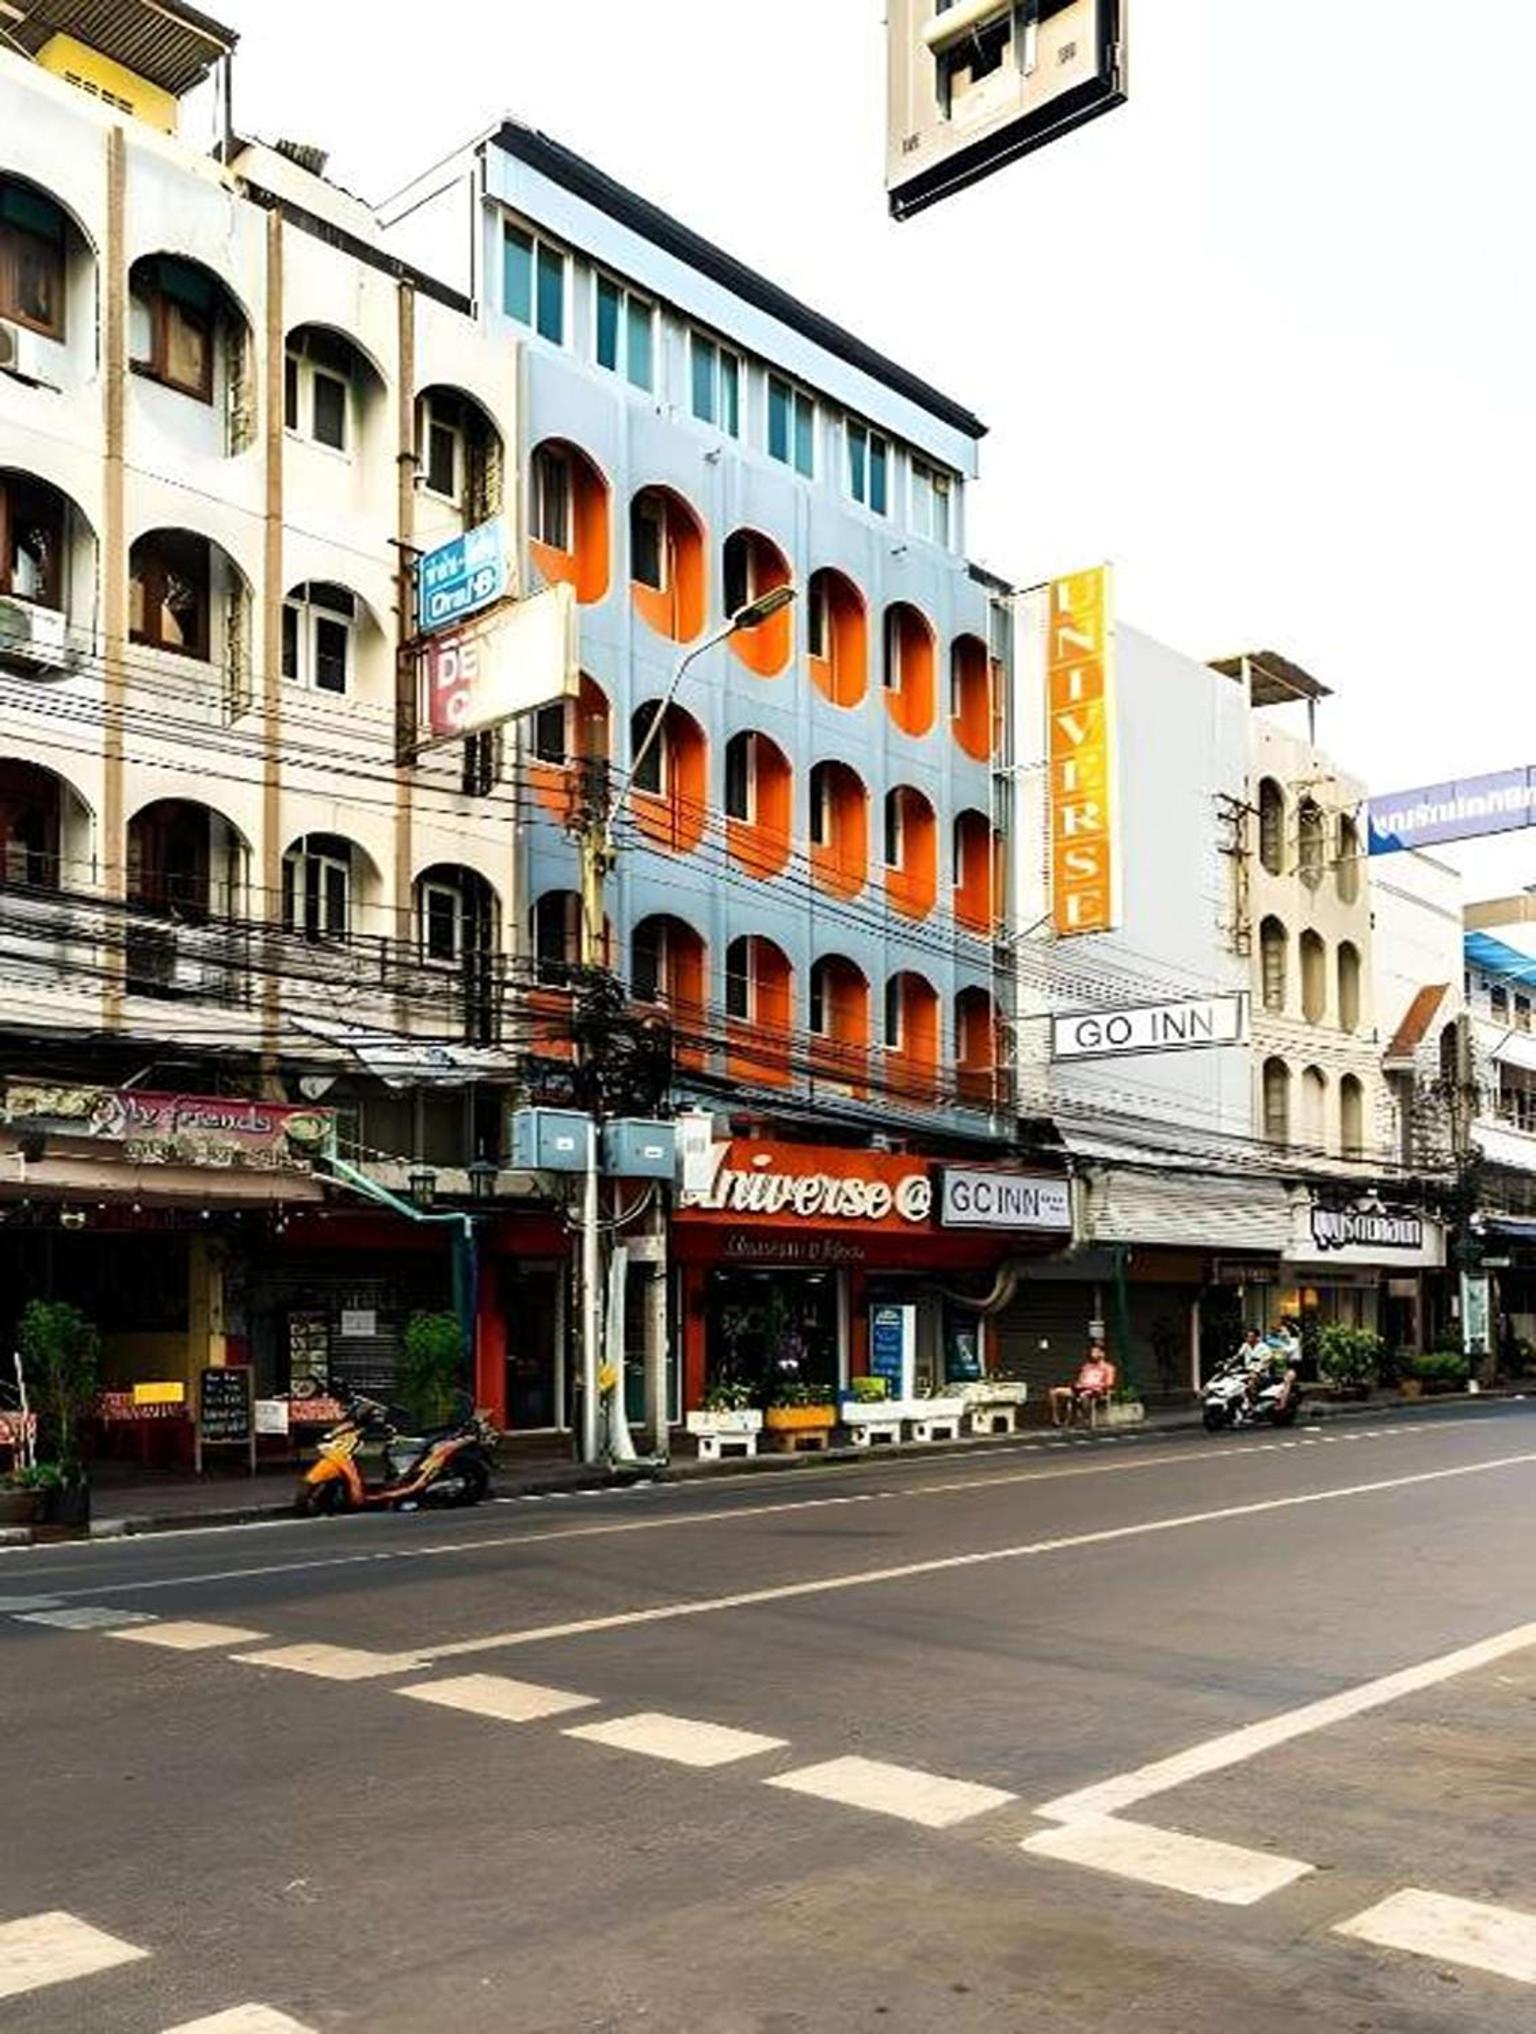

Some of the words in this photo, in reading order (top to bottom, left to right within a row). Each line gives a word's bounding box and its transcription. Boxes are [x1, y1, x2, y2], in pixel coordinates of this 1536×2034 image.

[1057, 575, 1102, 926] UNIVERSE
[1075, 1015, 1132, 1048] GO
[1151, 1006, 1213, 1042] INN
[997, 1185, 1040, 1216] INN
